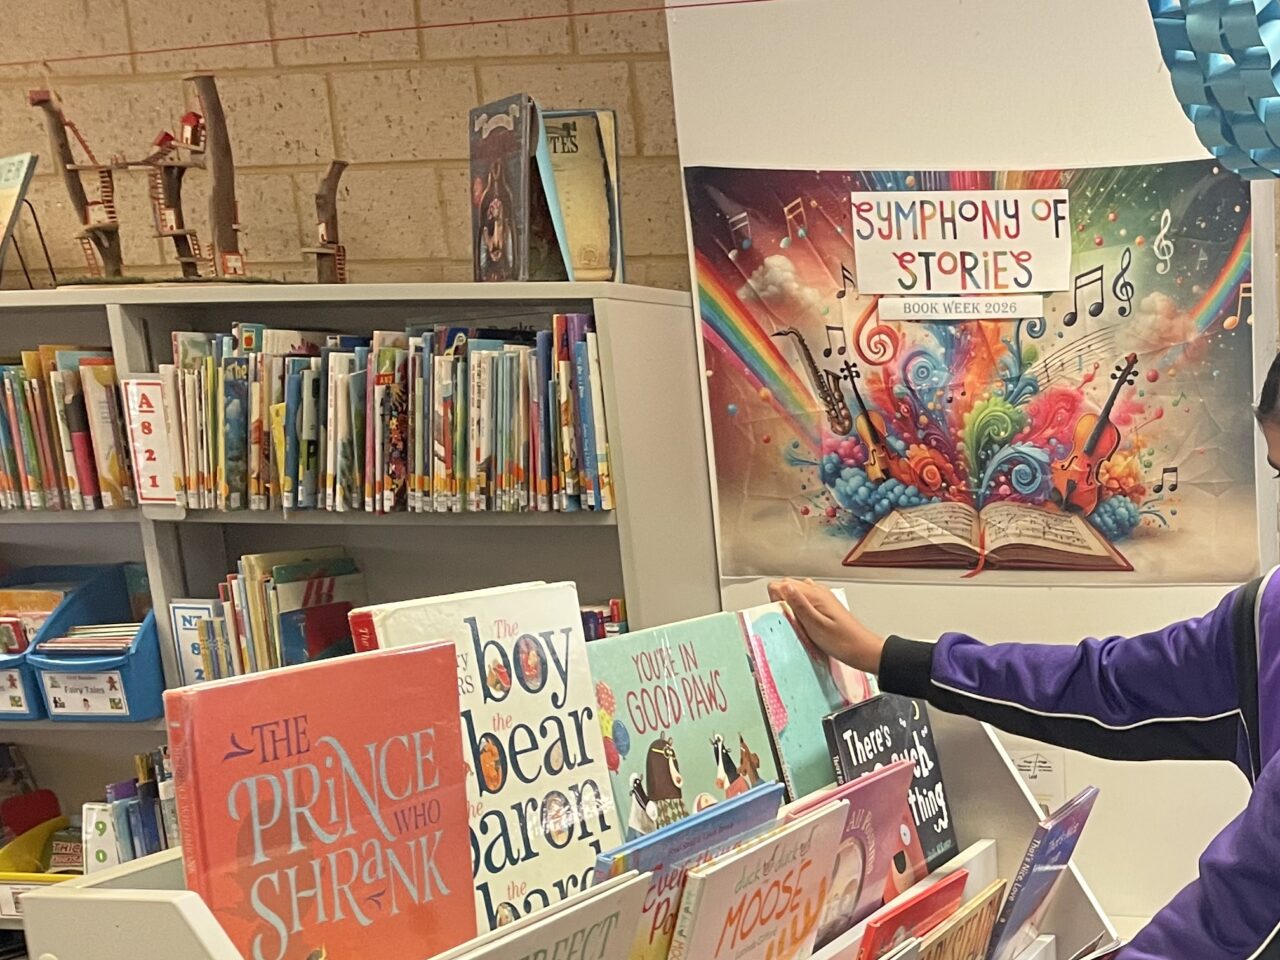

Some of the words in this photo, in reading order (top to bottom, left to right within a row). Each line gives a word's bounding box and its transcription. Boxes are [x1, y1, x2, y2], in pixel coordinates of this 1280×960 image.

[550, 135, 579, 154] TES
[854, 198, 1019, 240] SYMPHONY
[1032, 198, 1068, 239] OF
[902, 301, 938, 315] BOOK
[941, 301, 982, 315] WEEK
[984, 301, 1018, 315] 2026
[494, 619, 519, 638] The
[464, 616, 573, 710] boy
[631, 646, 680, 684] YOU'RE
[678, 640, 699, 673] IN
[492, 713, 512, 732] the
[626, 684, 682, 735] GOOD
[680, 669, 728, 721] PAWS
[250, 714, 311, 765] THE
[461, 706, 594, 798] bear
[842, 723, 893, 767] There's
[393, 799, 441, 836] WHO
[467, 801, 483, 818] he
[907, 781, 949, 834] thing
[714, 859, 813, 959] MOOSE
